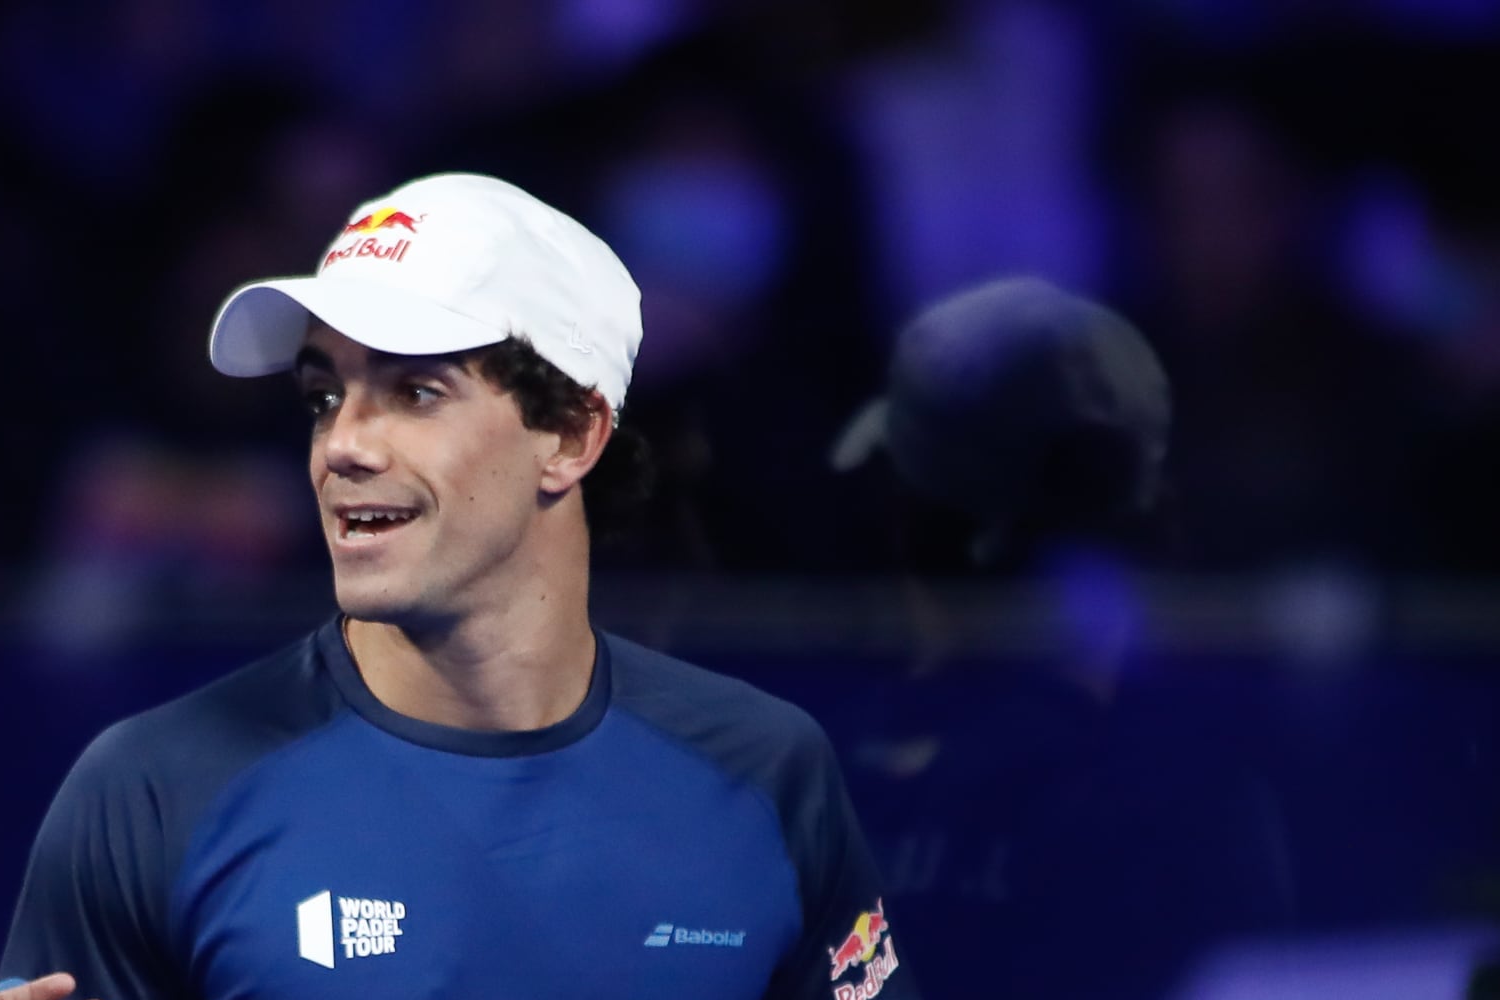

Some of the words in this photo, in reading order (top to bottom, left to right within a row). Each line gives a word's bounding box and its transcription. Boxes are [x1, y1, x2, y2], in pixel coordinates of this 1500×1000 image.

[357, 238, 411, 263] Bull
[339, 896, 406, 919] WORLD
[341, 918, 403, 938] PADEL
[675, 928, 746, 947] Babolat
[342, 936, 396, 959] TOUR
